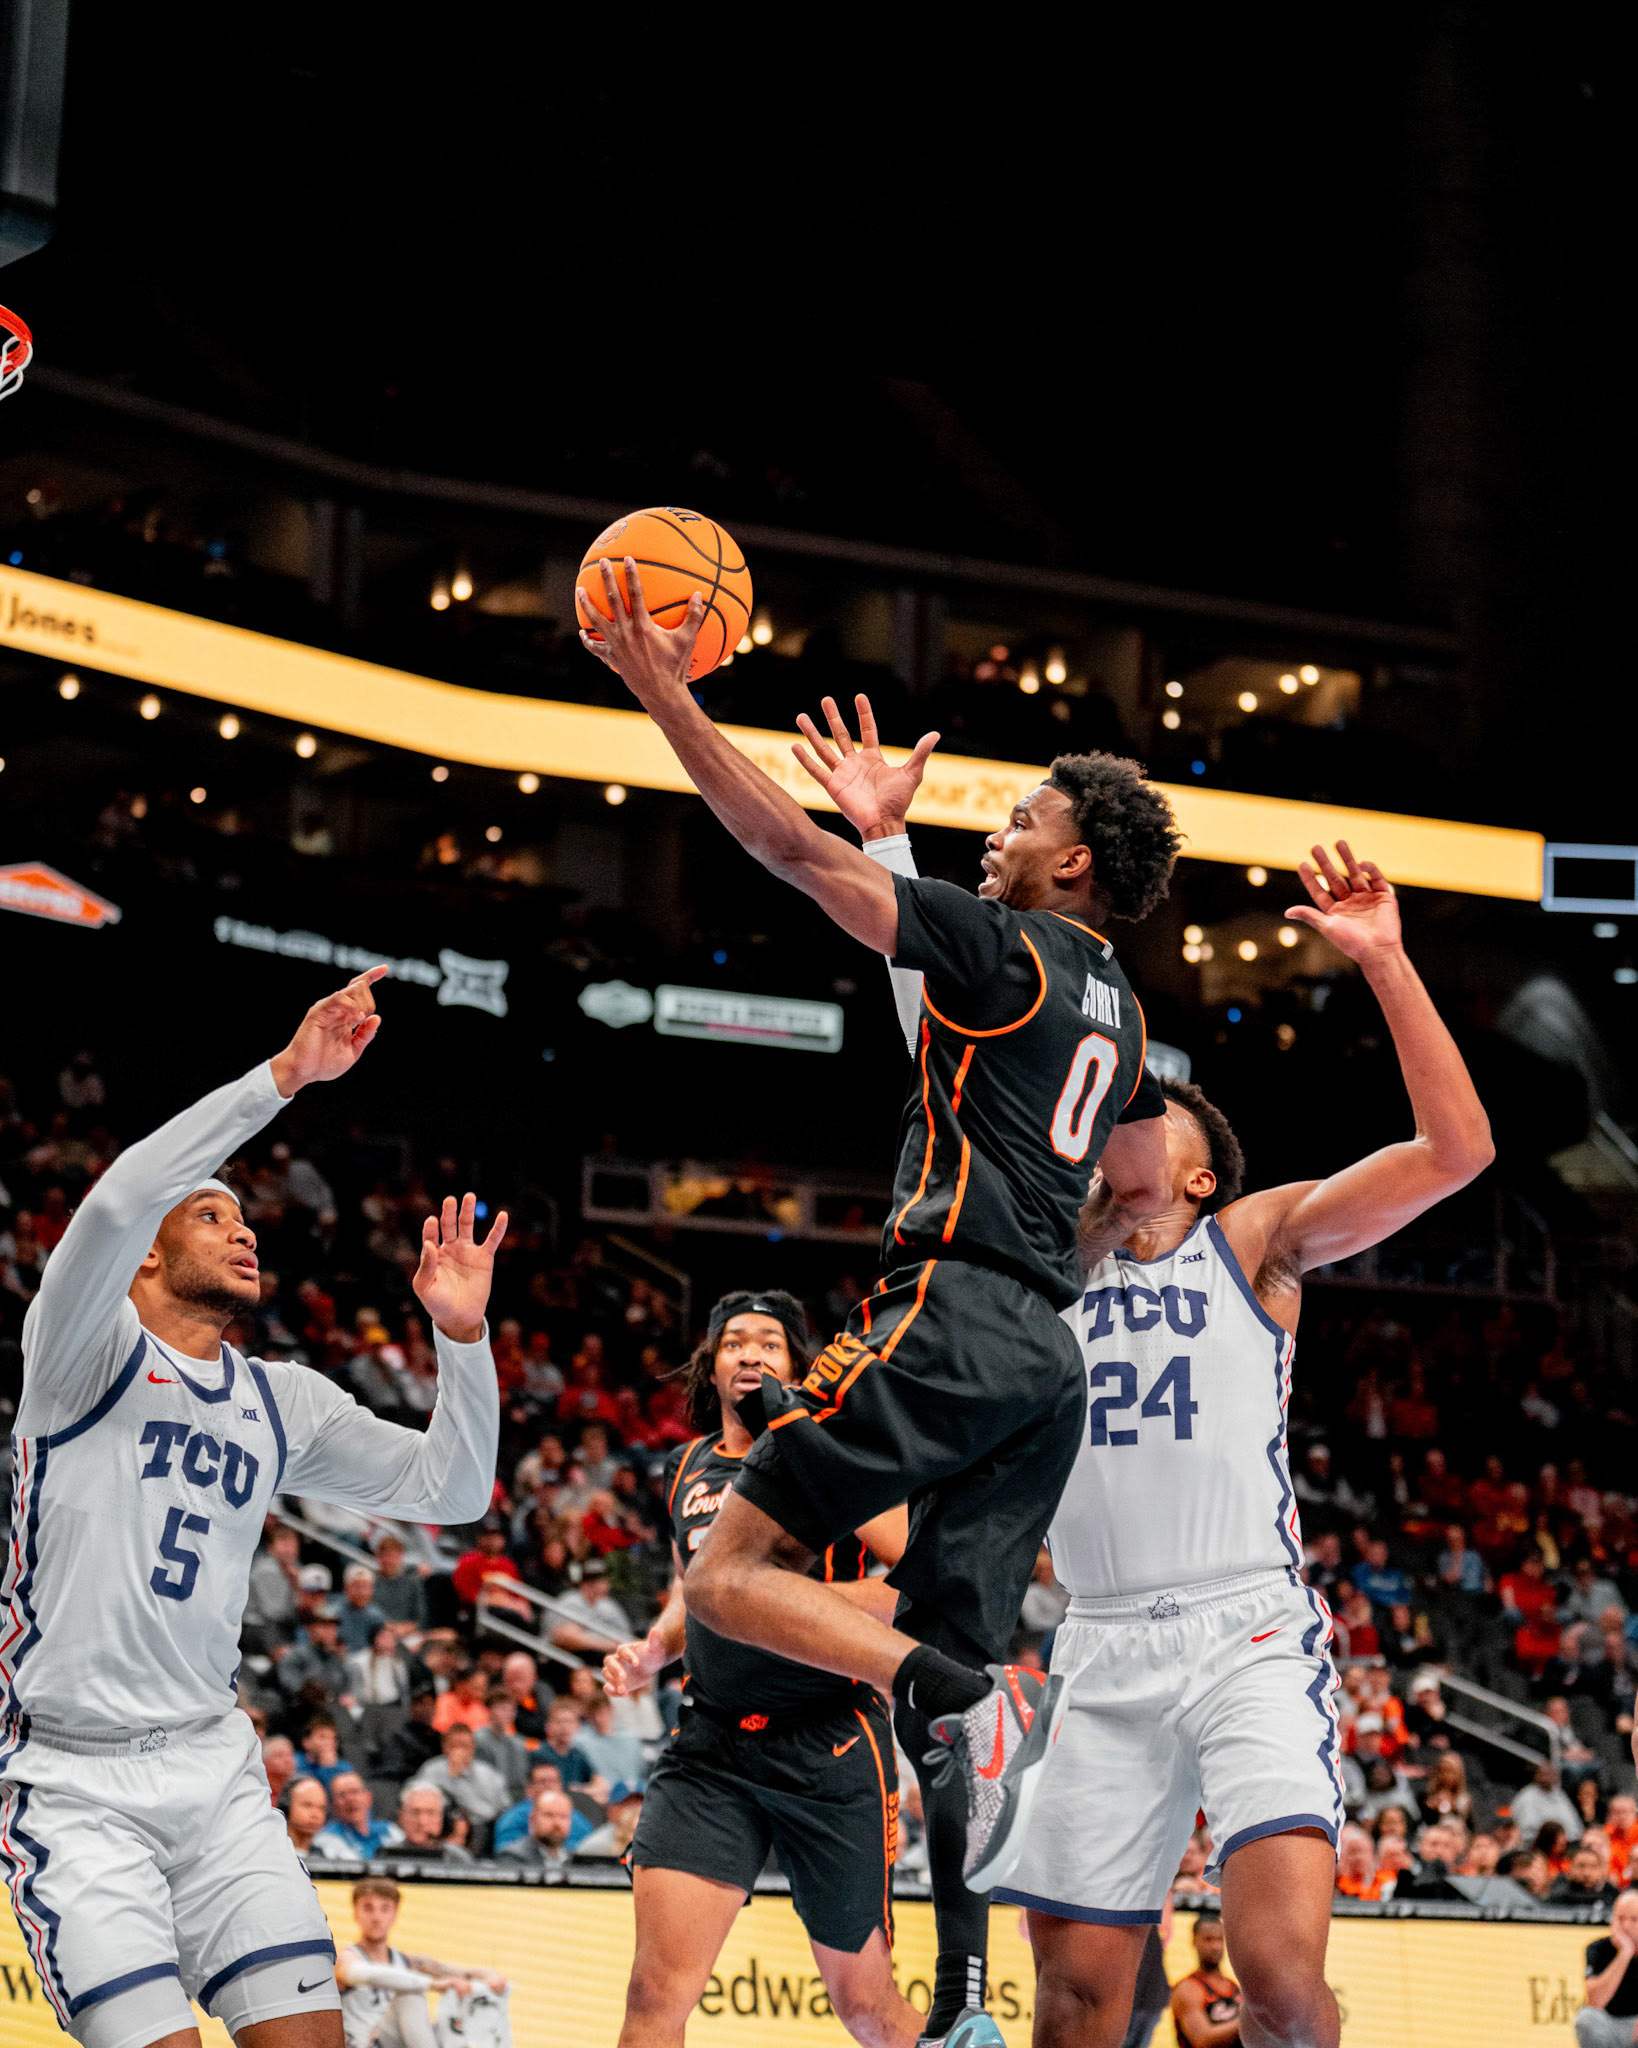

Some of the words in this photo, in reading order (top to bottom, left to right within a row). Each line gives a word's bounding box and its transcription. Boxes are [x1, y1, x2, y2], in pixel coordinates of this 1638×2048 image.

[8, 595, 95, 643] Jones
[1081, 972, 1121, 1029] CURRY
[1049, 1031, 1119, 1164] 0
[1082, 1283, 1210, 1344] TCU
[1090, 1356, 1199, 1447] 24
[138, 1421, 260, 1510] TCU
[682, 1480, 733, 1518] Cow
[149, 1505, 211, 1602] 5
[887, 1790, 900, 1866] POKES
